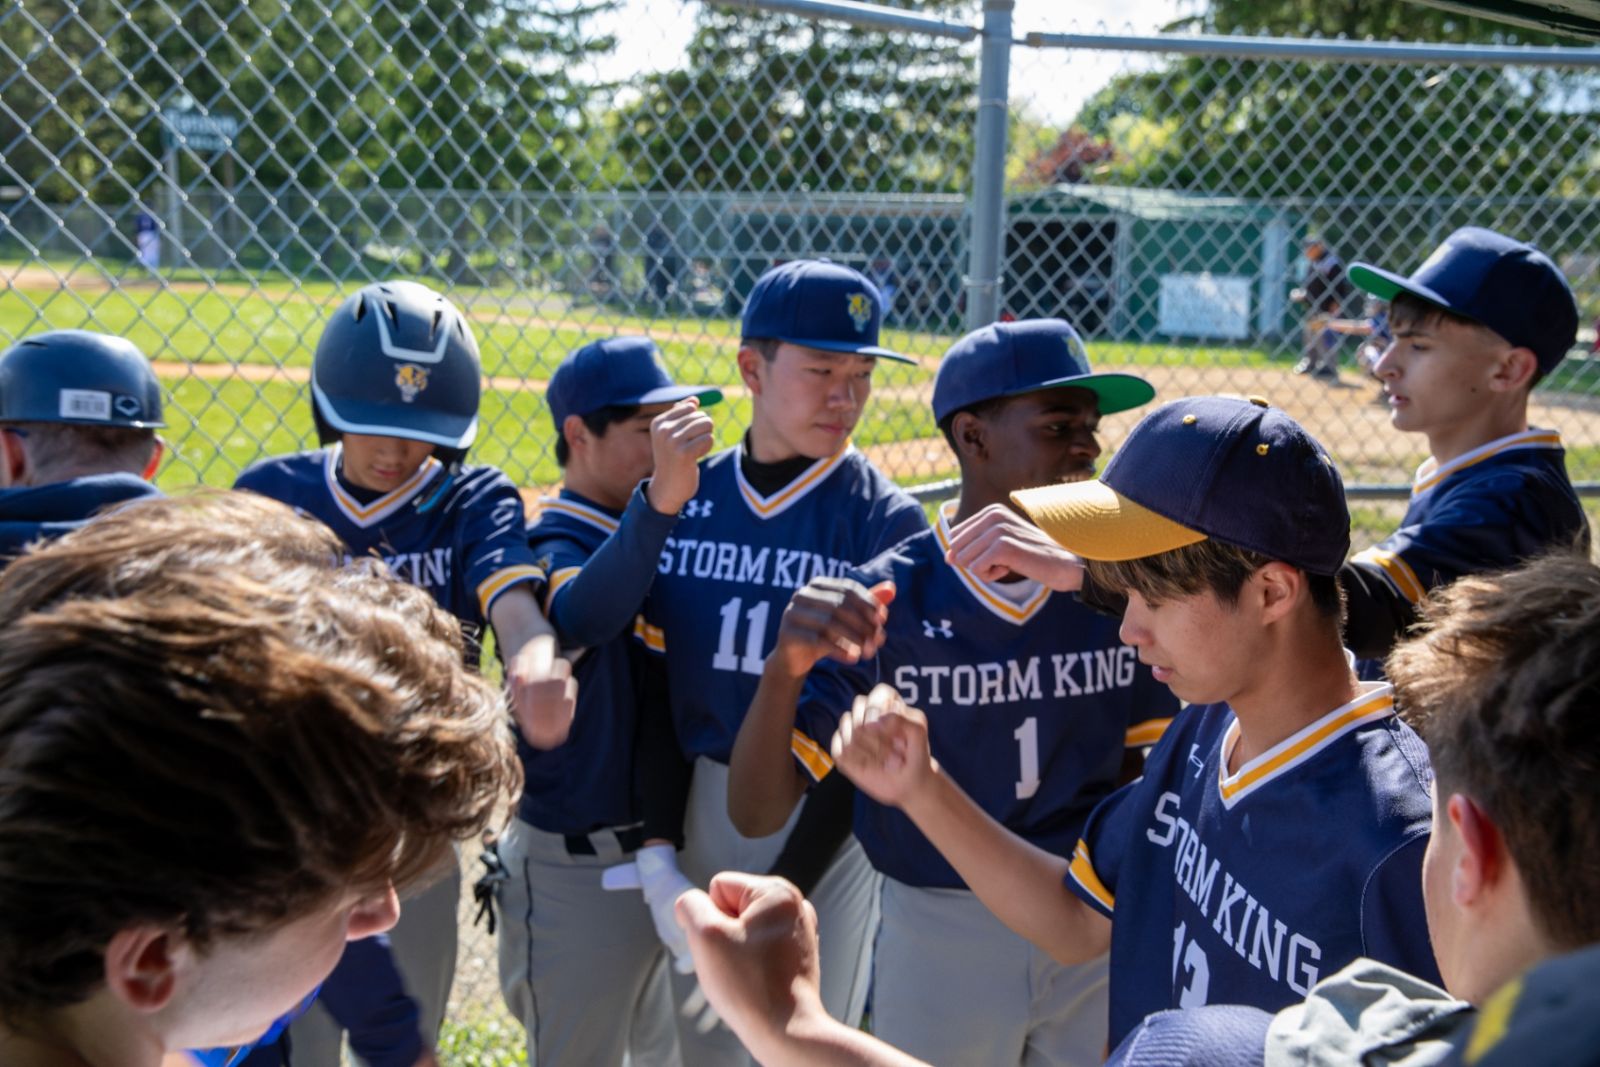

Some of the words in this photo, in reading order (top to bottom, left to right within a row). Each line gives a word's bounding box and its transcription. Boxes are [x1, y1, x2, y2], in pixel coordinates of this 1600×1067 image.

[657, 537, 770, 585] STORM
[712, 597, 770, 676] 11
[895, 657, 1043, 706] STORM
[1051, 646, 1136, 697] KING
[1013, 717, 1041, 799] 1
[1146, 791, 1221, 917] SORM
[1212, 871, 1322, 998] KING
